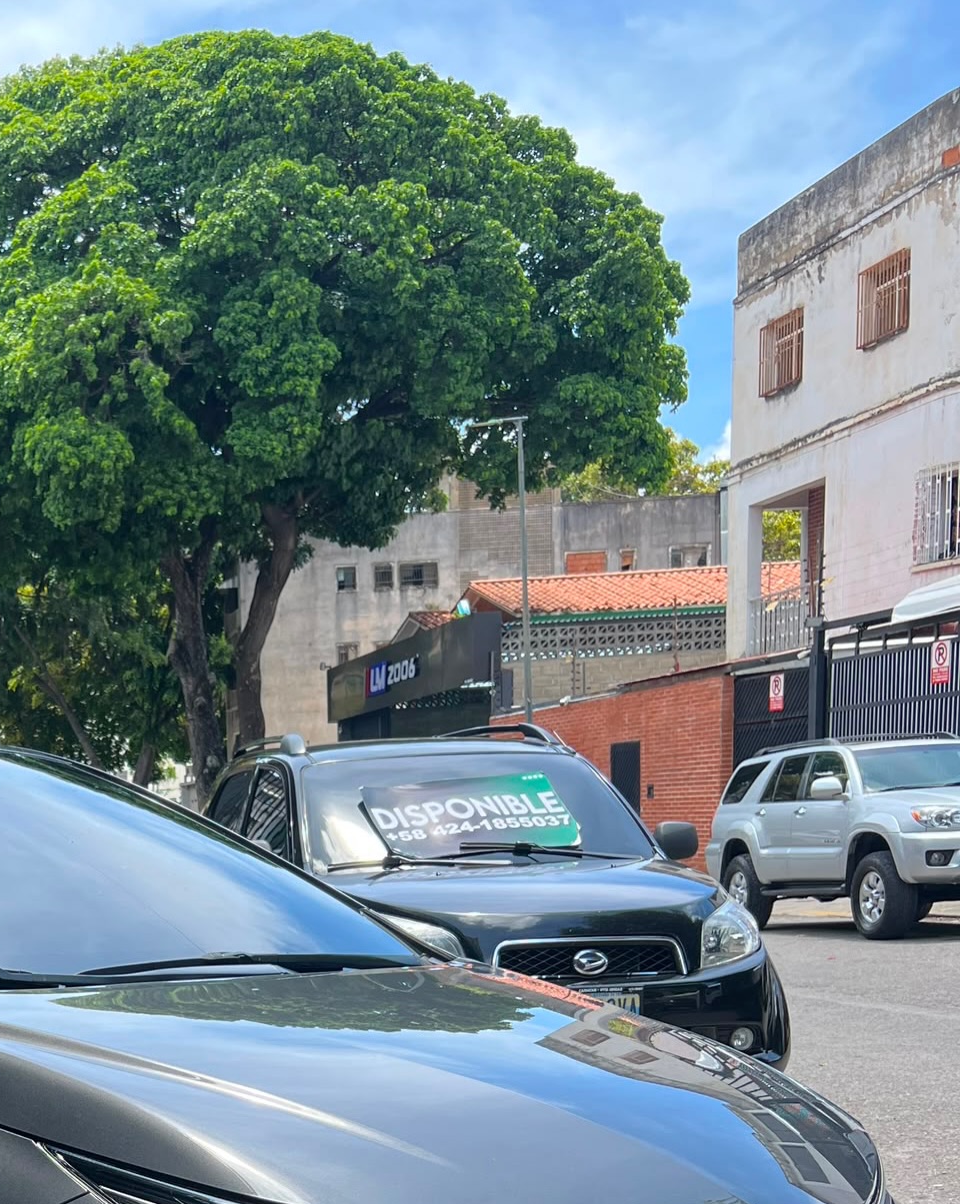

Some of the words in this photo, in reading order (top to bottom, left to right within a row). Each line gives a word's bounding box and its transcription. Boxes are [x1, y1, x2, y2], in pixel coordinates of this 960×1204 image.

[370, 664, 386, 692] LM
[387, 657, 416, 685] 2006
[370, 791, 566, 830] DISPONIBLE
[386, 829, 428, 841] +58
[432, 814, 570, 836] 424-1855037
